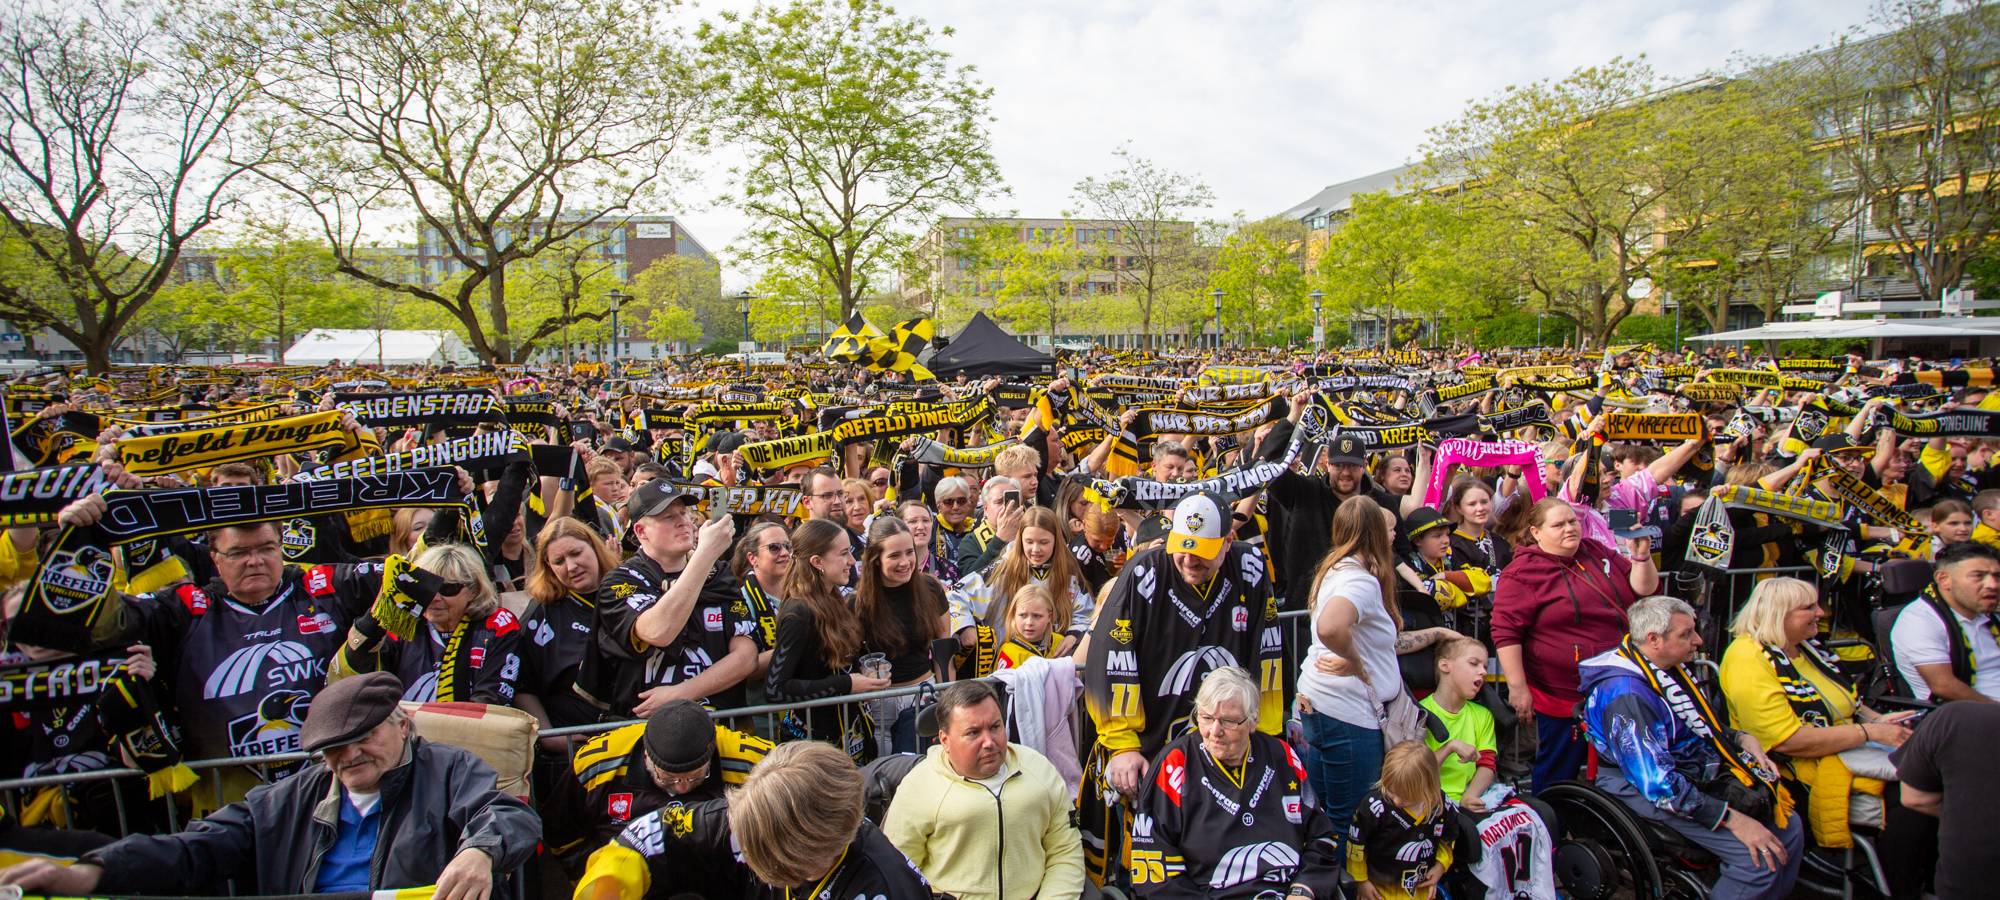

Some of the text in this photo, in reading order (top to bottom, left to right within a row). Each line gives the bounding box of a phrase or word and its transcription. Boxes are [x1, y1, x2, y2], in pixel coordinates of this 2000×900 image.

[1439, 379, 1492, 401] PINGUINE
[1724, 371, 1747, 382] MACHT
[1749, 372, 1760, 383] AM
[1760, 373, 1779, 385] RHEIN
[999, 392, 1026, 400] KREFELD
[1225, 382, 1265, 400] DER
[336, 393, 495, 420] SEIDENSTADT
[515, 403, 555, 414] WALK
[833, 414, 907, 442] KREFELD
[1150, 413, 1191, 433] NUR
[1193, 414, 1231, 433] DER
[1608, 414, 1698, 436] KEV KREFELD
[1892, 412, 1990, 432] WIR SIND PINGUINE
[411, 430, 524, 470] PINGUINE
[750, 444, 771, 464] DIE
[773, 436, 812, 461] MACHT
[97, 471, 455, 535] KREFELD
[759, 488, 803, 514] KEV
[1691, 536, 1729, 551] KREFELD
[41, 568, 107, 595] KREFELD
[243, 627, 282, 641] TRUE
[267, 656, 327, 688] SWK
[1107, 649, 1138, 671] MV
[1261, 655, 1283, 692] 11
[1110, 683, 1141, 717] 11
[232, 733, 299, 757] KREFE
[1201, 775, 1241, 811] Conrad
[1131, 849, 1165, 885] 55
